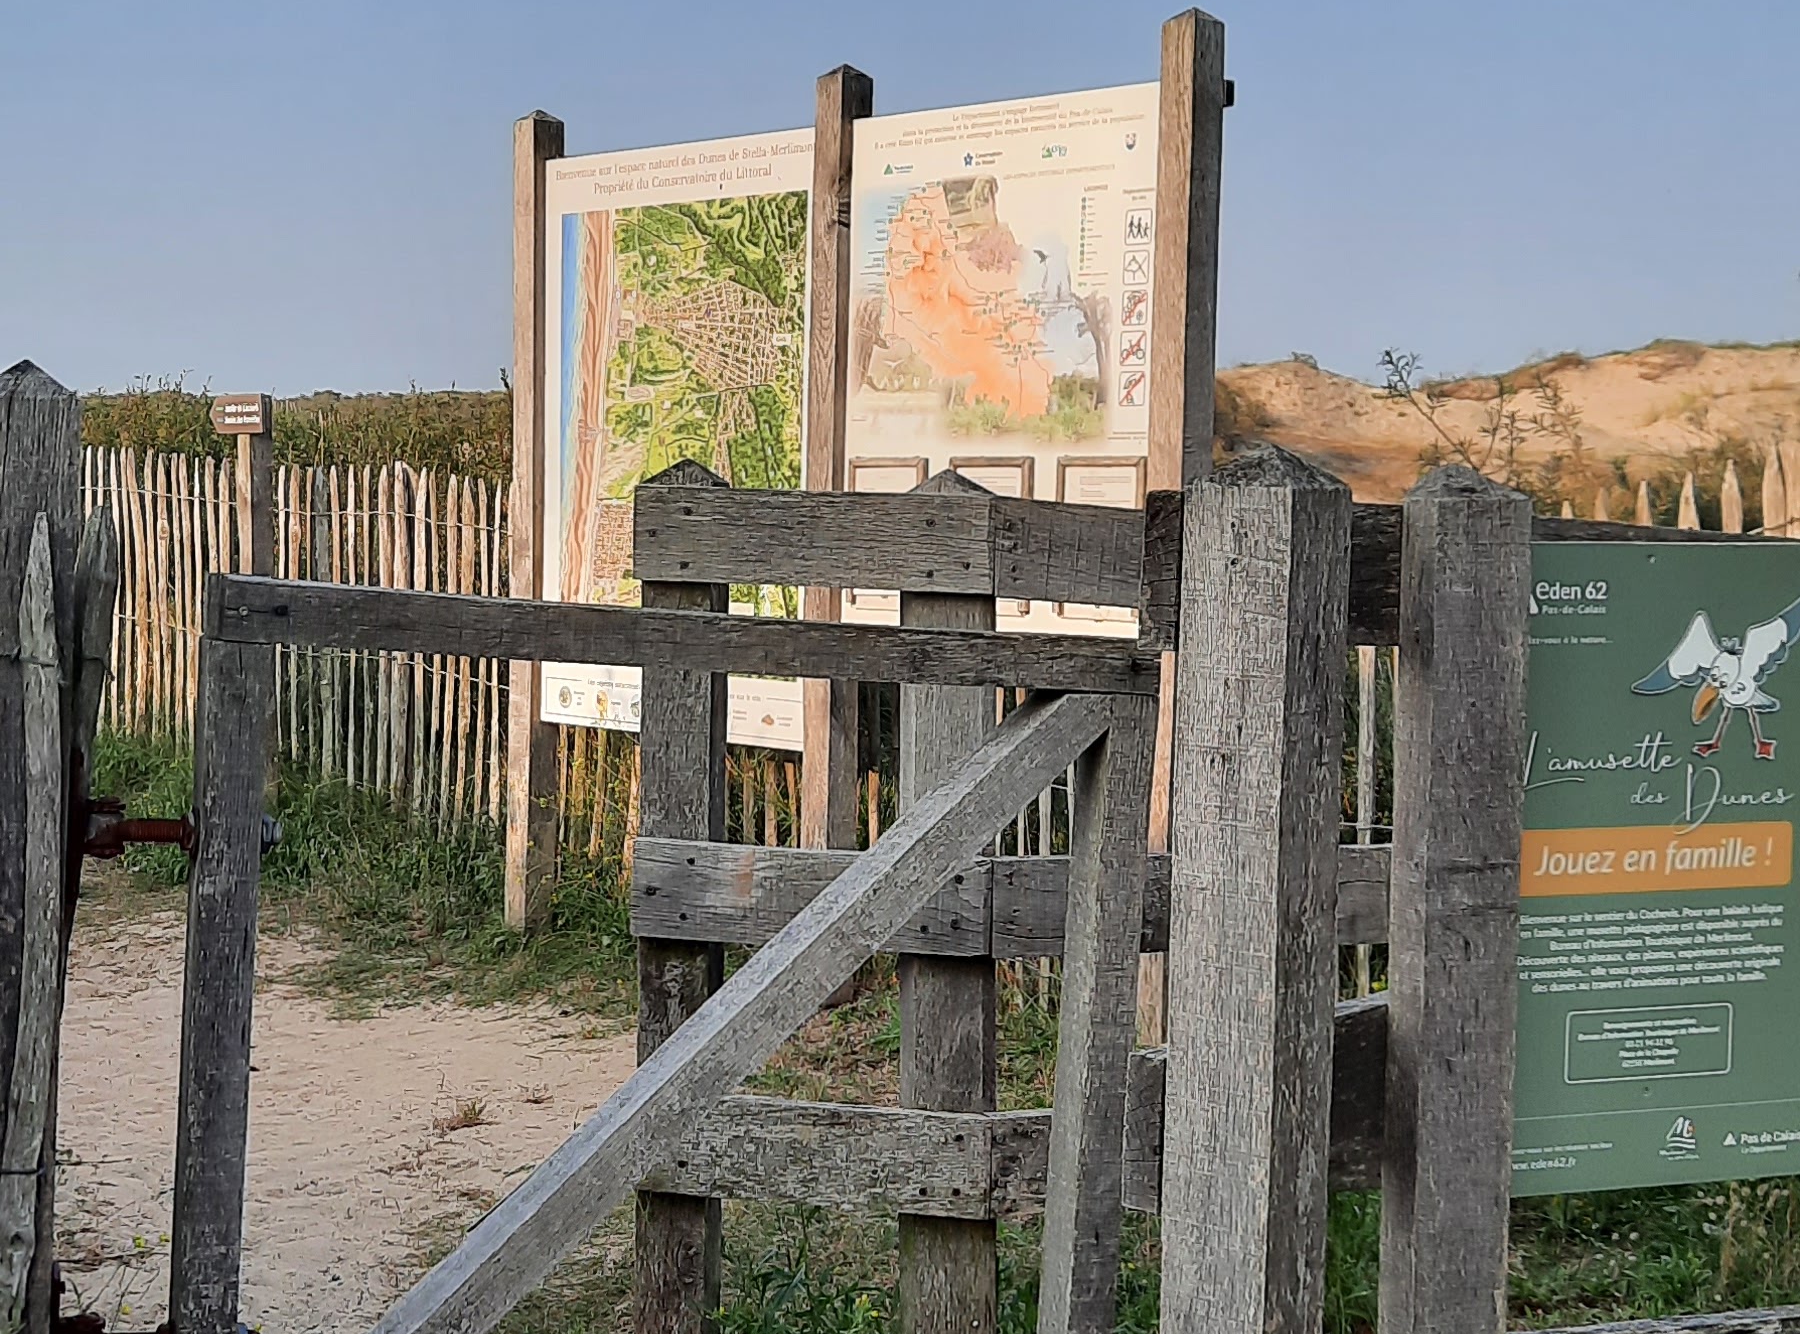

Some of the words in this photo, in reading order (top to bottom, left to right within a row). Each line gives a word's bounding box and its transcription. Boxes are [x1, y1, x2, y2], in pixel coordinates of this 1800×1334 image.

[636, 177, 649, 190] du
[720, 169, 732, 181] du
[736, 163, 772, 179] Littoral
[1585, 581, 1608, 600] 62
[1631, 782, 1669, 806] des
[1671, 763, 1795, 835] Dunes
[1533, 845, 1616, 877] Jouez
[1623, 851, 1656, 872] en
[1664, 839, 1757, 875] famille
[1764, 836, 1774, 865] !
